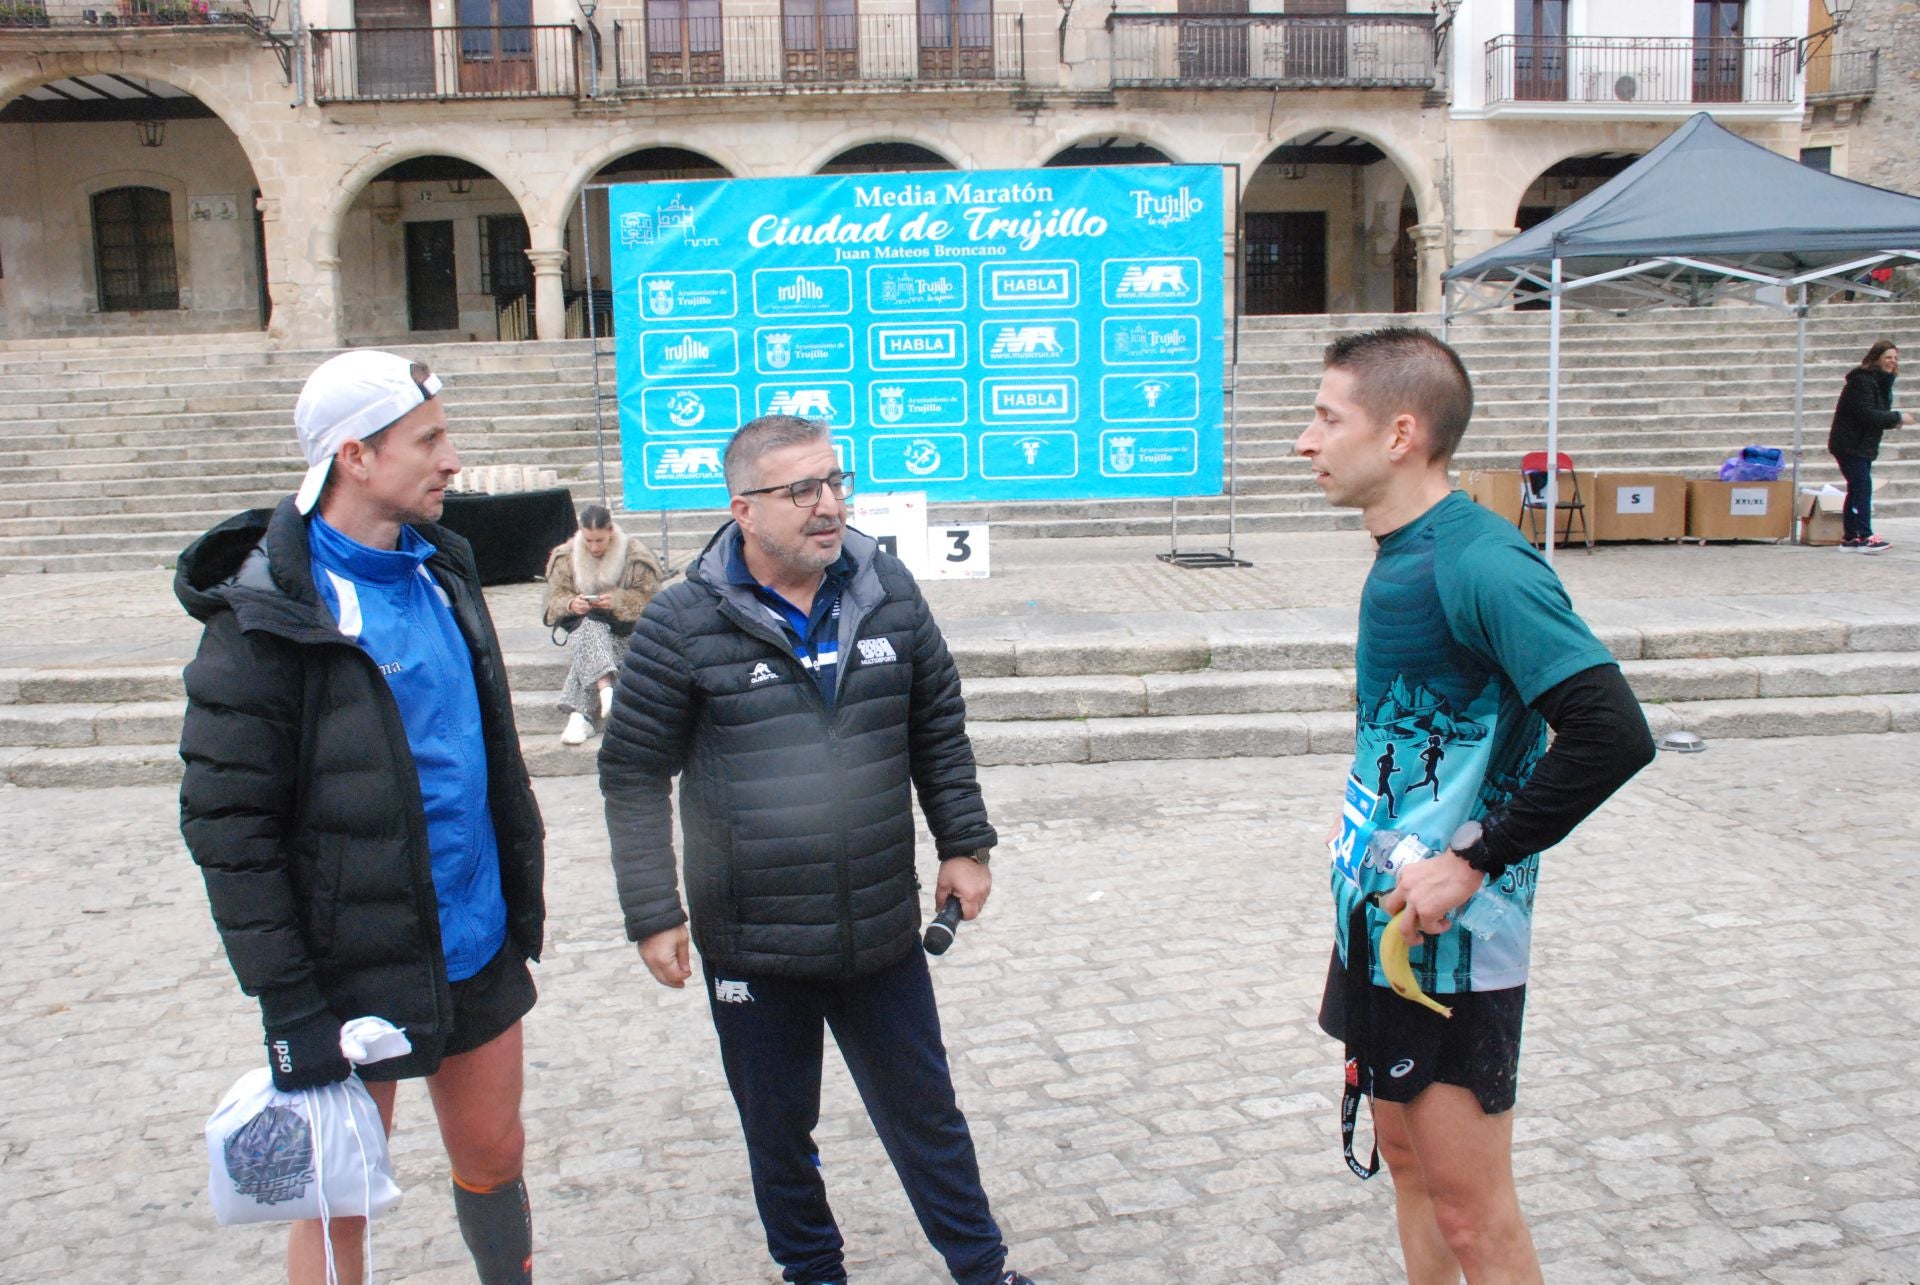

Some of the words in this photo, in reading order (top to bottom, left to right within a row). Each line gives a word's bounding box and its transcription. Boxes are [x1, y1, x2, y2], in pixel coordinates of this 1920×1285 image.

[854, 184, 937, 208] Media
[945, 182, 1054, 205] Maratón
[1129, 186, 1203, 219] Trujillo
[748, 212, 893, 248] Ciudad
[899, 212, 954, 242] de
[963, 206, 1108, 252] Trujillo
[834, 247, 870, 263] Juan
[874, 245, 930, 259] Mateos
[934, 244, 1007, 257] Broncano
[915, 277, 953, 294] Trujillo
[1003, 279, 1058, 292] HABLA
[678, 296, 712, 307] Trujillo
[890, 338, 944, 351] HABLA
[795, 350, 829, 360] Trujillo
[990, 351, 1060, 359] www.musicrun.es
[1003, 393, 1057, 407] HABLA
[908, 403, 942, 414] Trujillo
[1138, 453, 1173, 464] Trujillo
[655, 472, 723, 480] www.musicrun.es
[1631, 494, 1641, 504] S
[877, 535, 898, 559] 1
[946, 530, 972, 563] 3
[377, 660, 402, 676] ma
